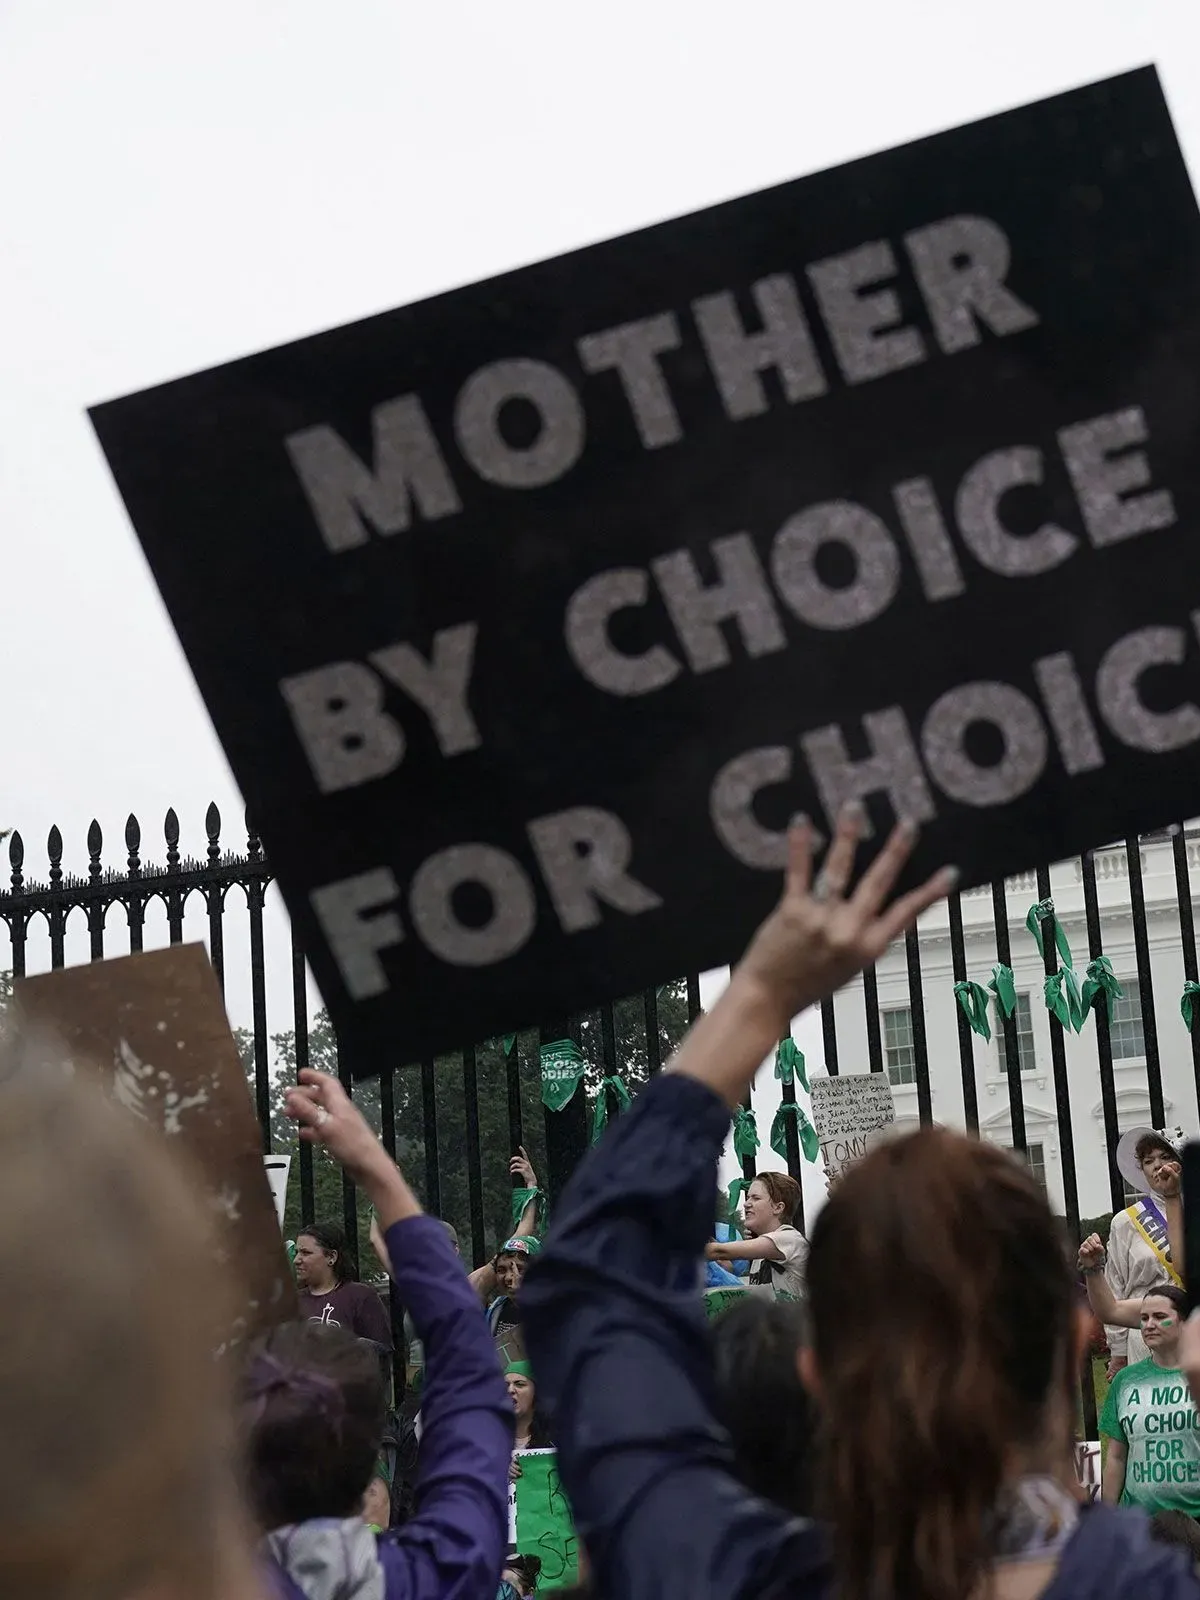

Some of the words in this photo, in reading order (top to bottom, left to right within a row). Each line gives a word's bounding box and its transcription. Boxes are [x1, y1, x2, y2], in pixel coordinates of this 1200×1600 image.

[284, 213, 1039, 553] MOTHER
[279, 623, 481, 795] BY
[309, 807, 662, 999] FOR
[541, 1070, 576, 1081] ODIES
[1128, 1388, 1140, 1406] A
[1145, 1439, 1185, 1461] FOR
[1133, 1460, 1200, 1483] CHOICE
